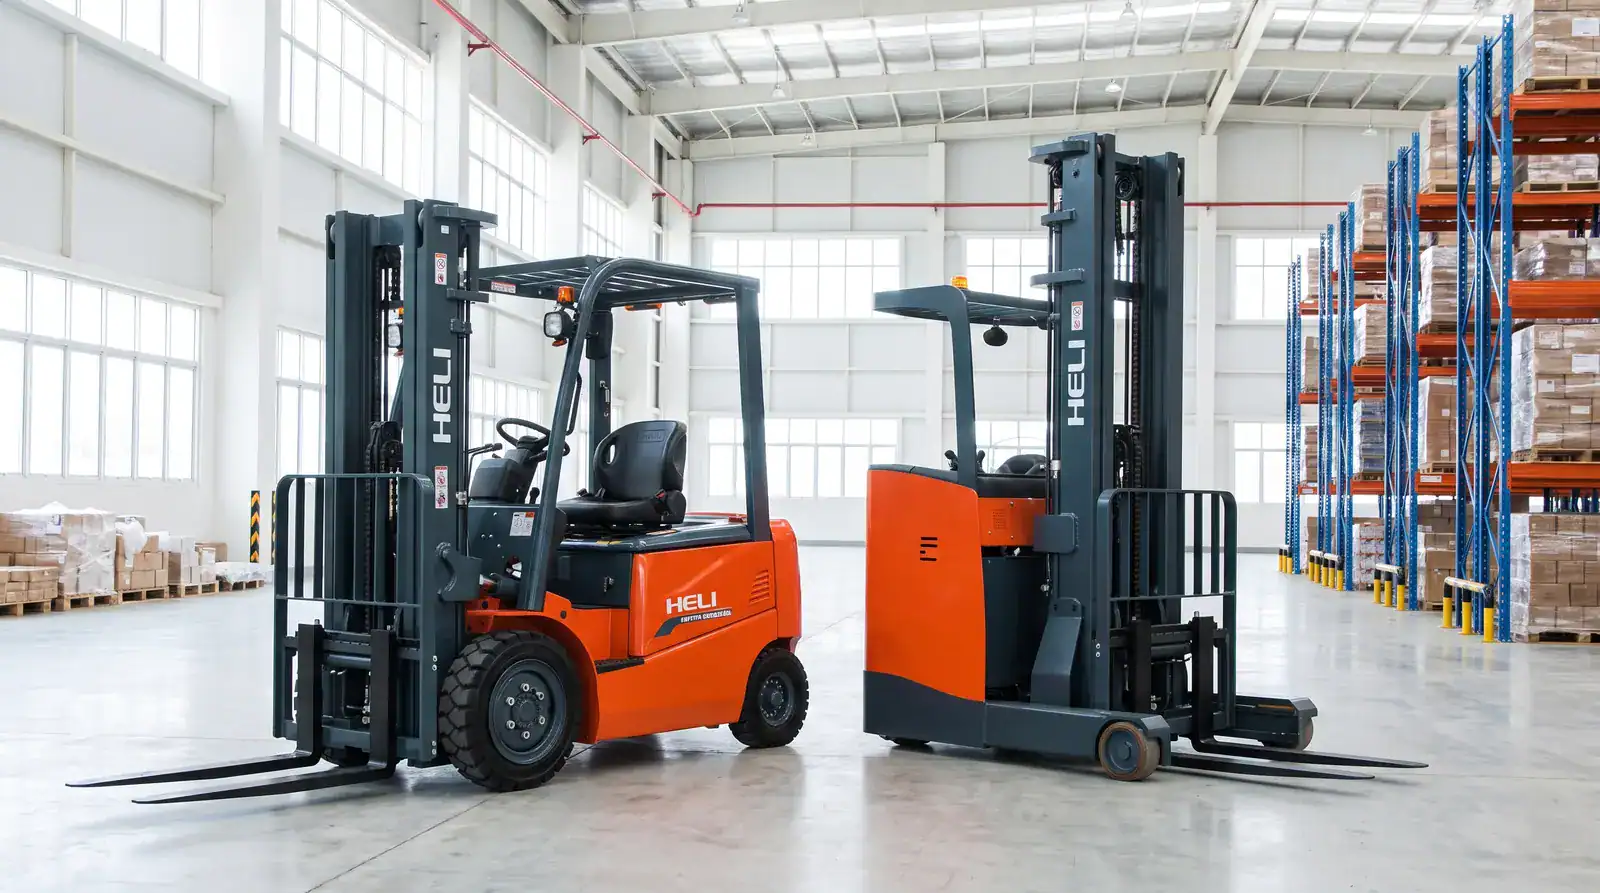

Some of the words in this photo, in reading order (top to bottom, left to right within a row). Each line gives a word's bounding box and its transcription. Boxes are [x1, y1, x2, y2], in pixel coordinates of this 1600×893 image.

[433, 348, 451, 443] HELI
[1068, 340, 1085, 426] HELI
[666, 591, 716, 614] HELI
